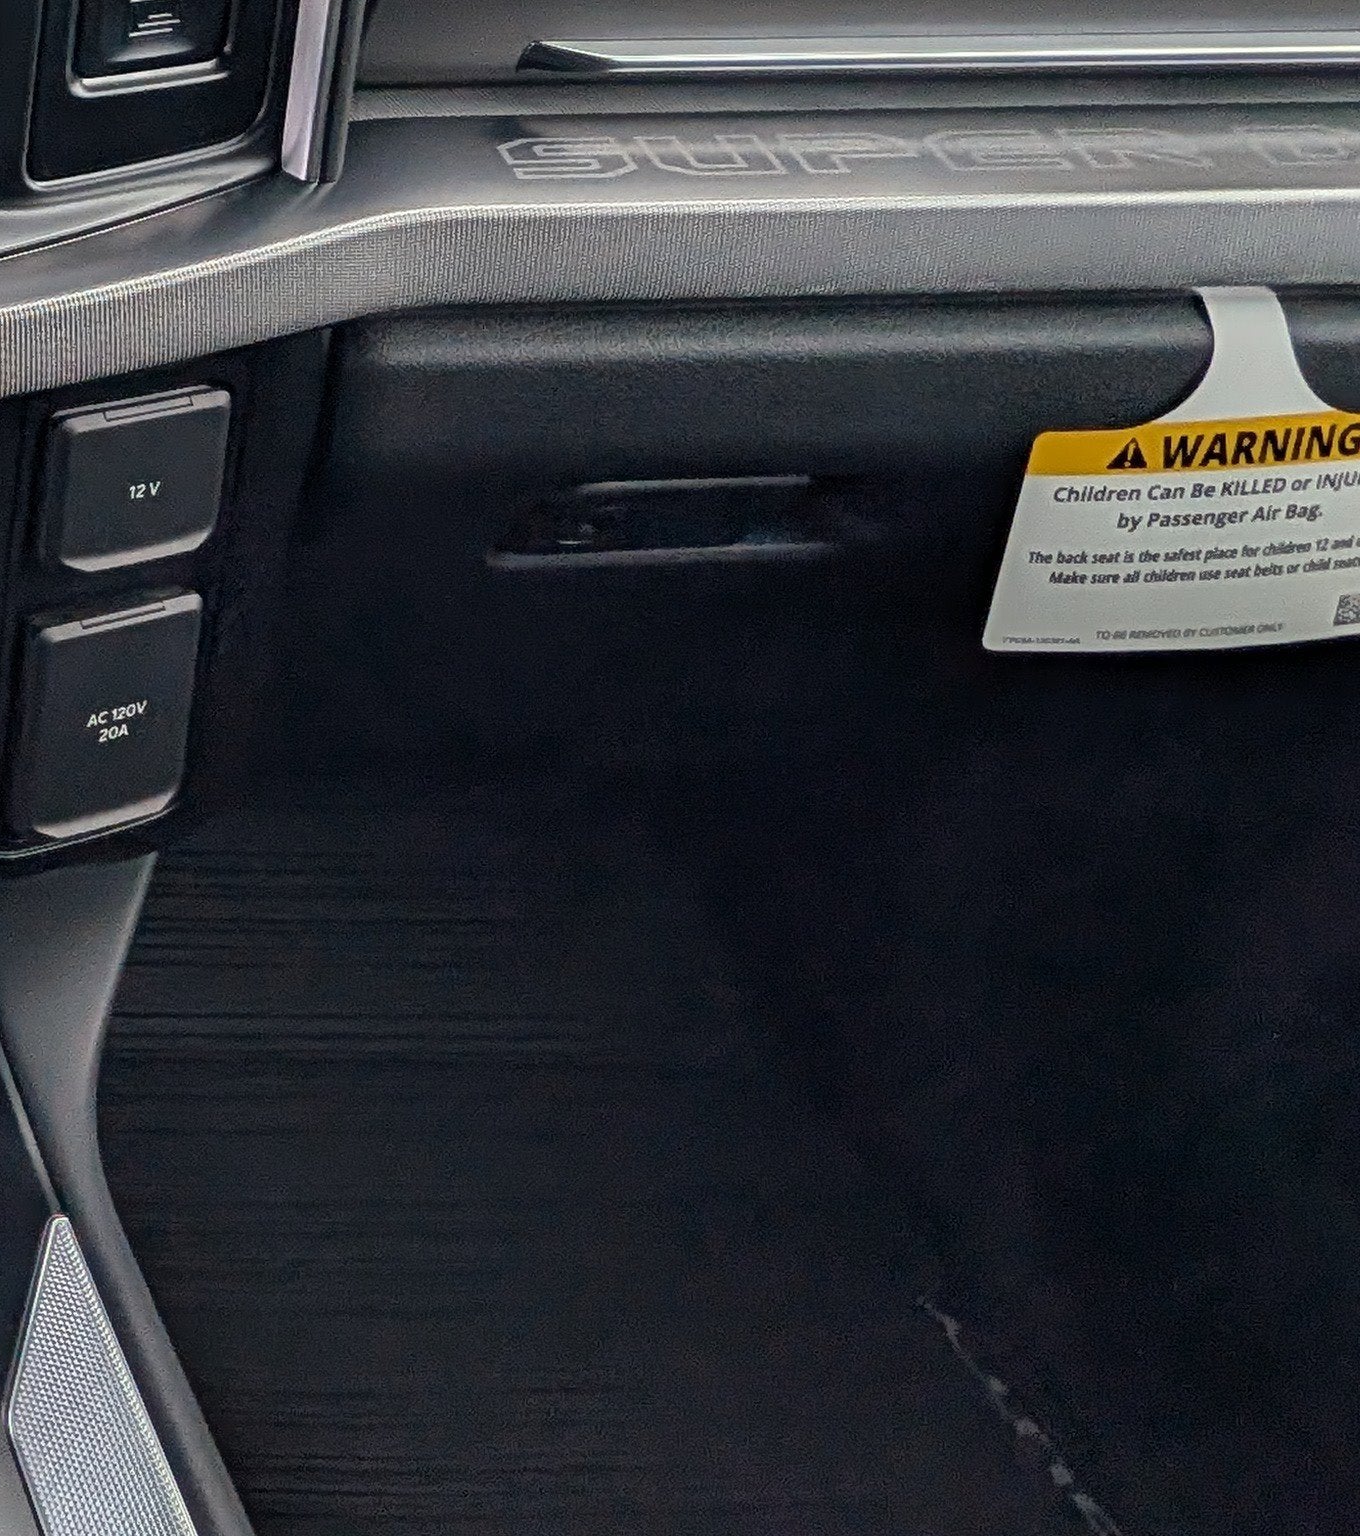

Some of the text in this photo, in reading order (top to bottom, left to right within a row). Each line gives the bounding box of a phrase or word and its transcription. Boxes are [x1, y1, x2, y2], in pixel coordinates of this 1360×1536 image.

[497, 127, 1214, 180] SUPER
[1162, 422, 1360, 469] WARNING
[129, 480, 162, 500] 12 V
[1054, 485, 1142, 503] Children
[1147, 484, 1186, 501] Can
[1190, 482, 1216, 499] Be
[1220, 478, 1287, 497] KILLED
[1291, 478, 1313, 491] or
[1116, 503, 1323, 533] by Passenger Air Bag.
[1029, 551, 1053, 564] The
[1056, 550, 1088, 564] back
[1091, 551, 1121, 564] seat
[1138, 549, 1161, 563] the
[1163, 548, 1202, 563] safest
[1203, 546, 1238, 563] place
[1241, 544, 1261, 558] for
[1262, 541, 1311, 557] children
[1049, 570, 1087, 585] Make
[1090, 573, 1121, 584] sure
[1143, 568, 1196, 583] children
[1199, 569, 1222, 581] use
[1224, 566, 1252, 579] seat
[1286, 563, 1301, 574] or
[1302, 557, 1331, 573] child
[86, 699, 148, 729] AC 120V
[97, 723, 129, 743] 20A
